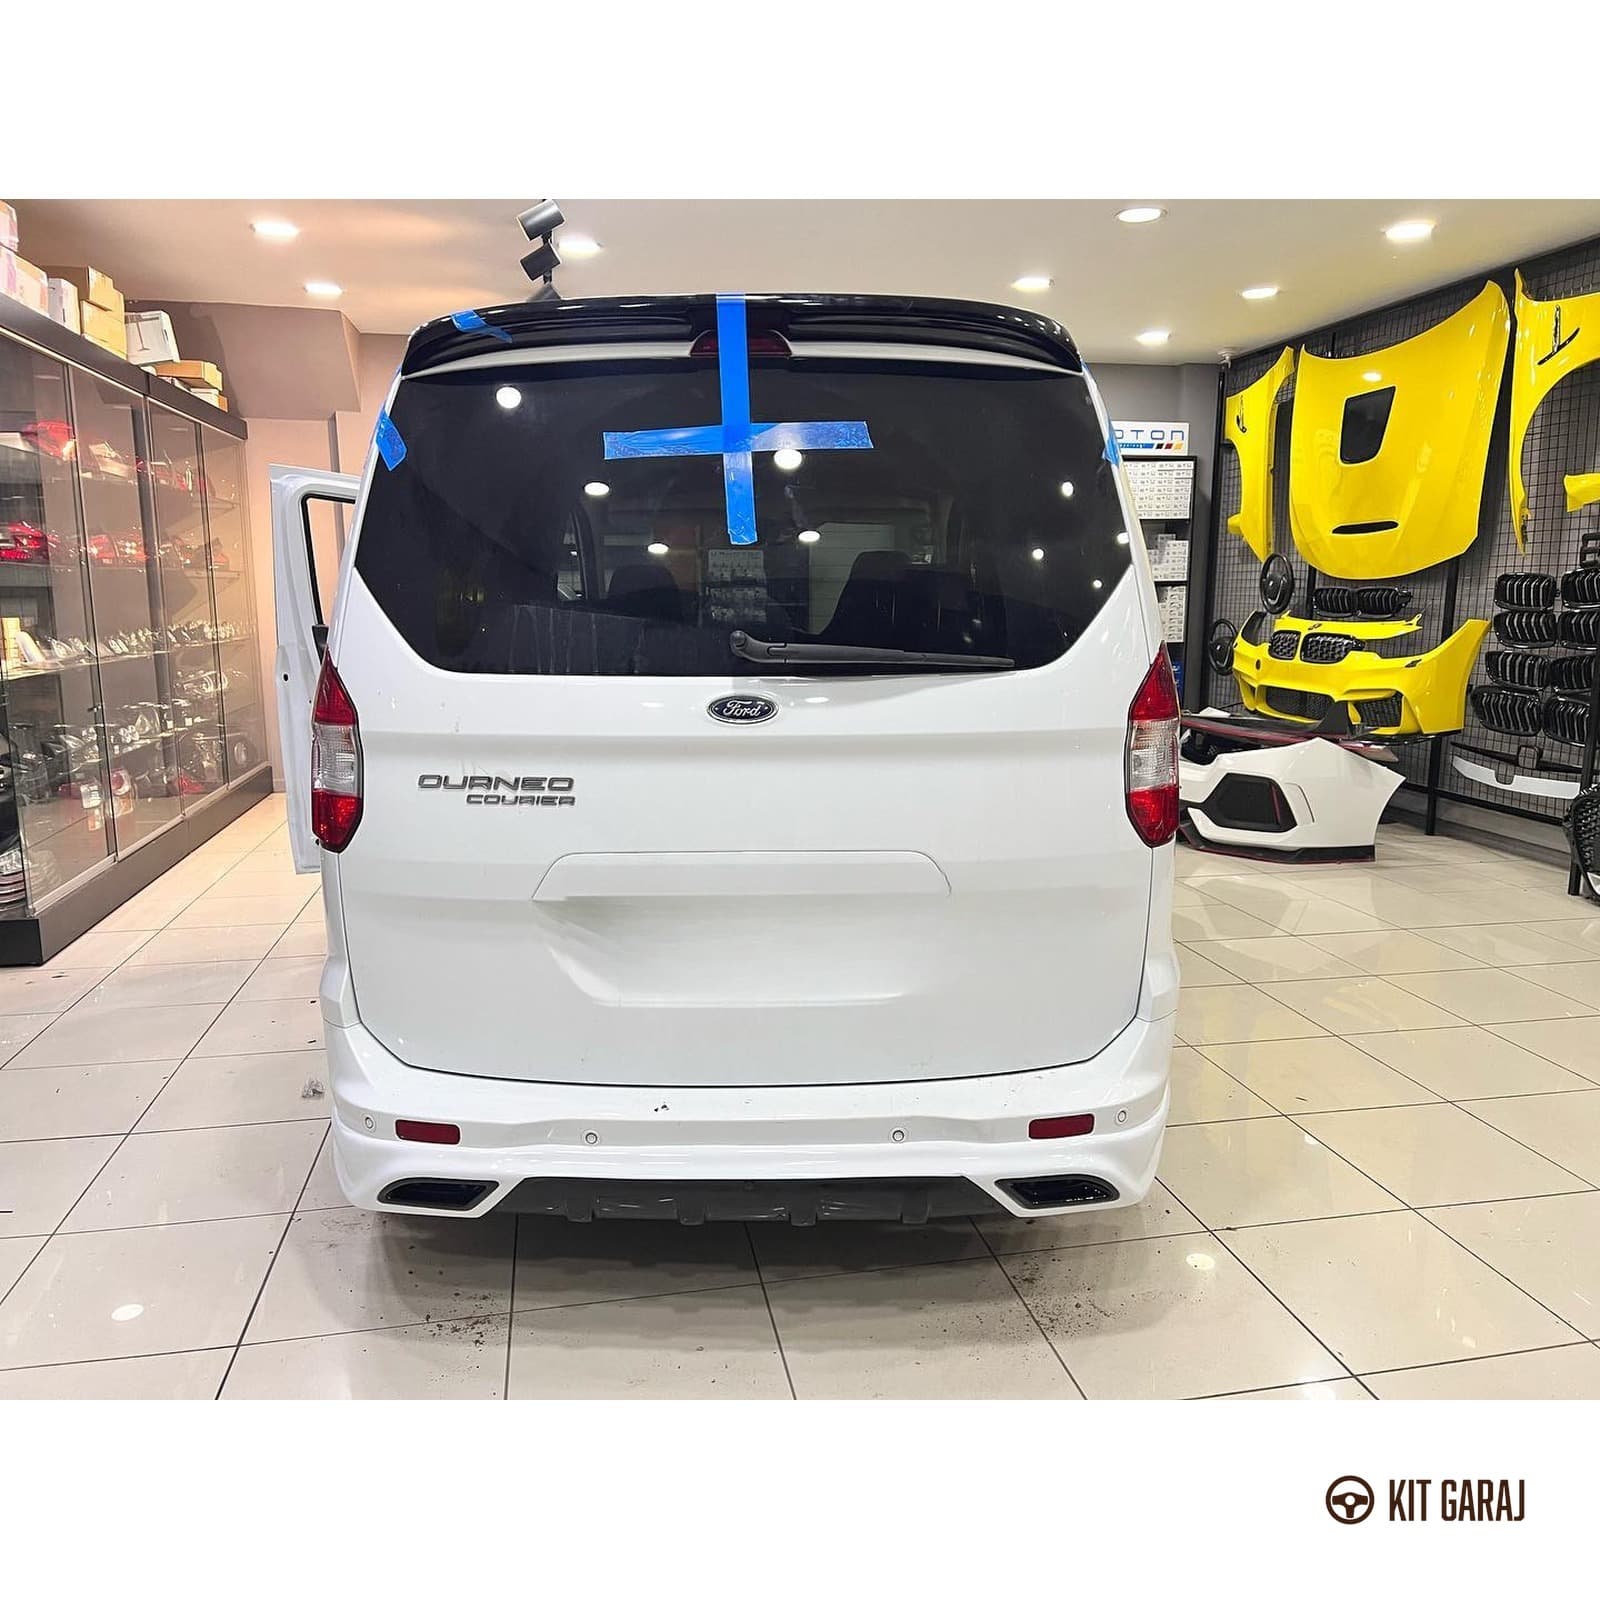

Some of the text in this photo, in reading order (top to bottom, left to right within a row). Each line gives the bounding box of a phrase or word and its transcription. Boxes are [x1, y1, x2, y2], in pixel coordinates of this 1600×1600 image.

[722, 700, 765, 717] Ford
[417, 774, 575, 792] OURNEO
[466, 794, 576, 807] COURIER
